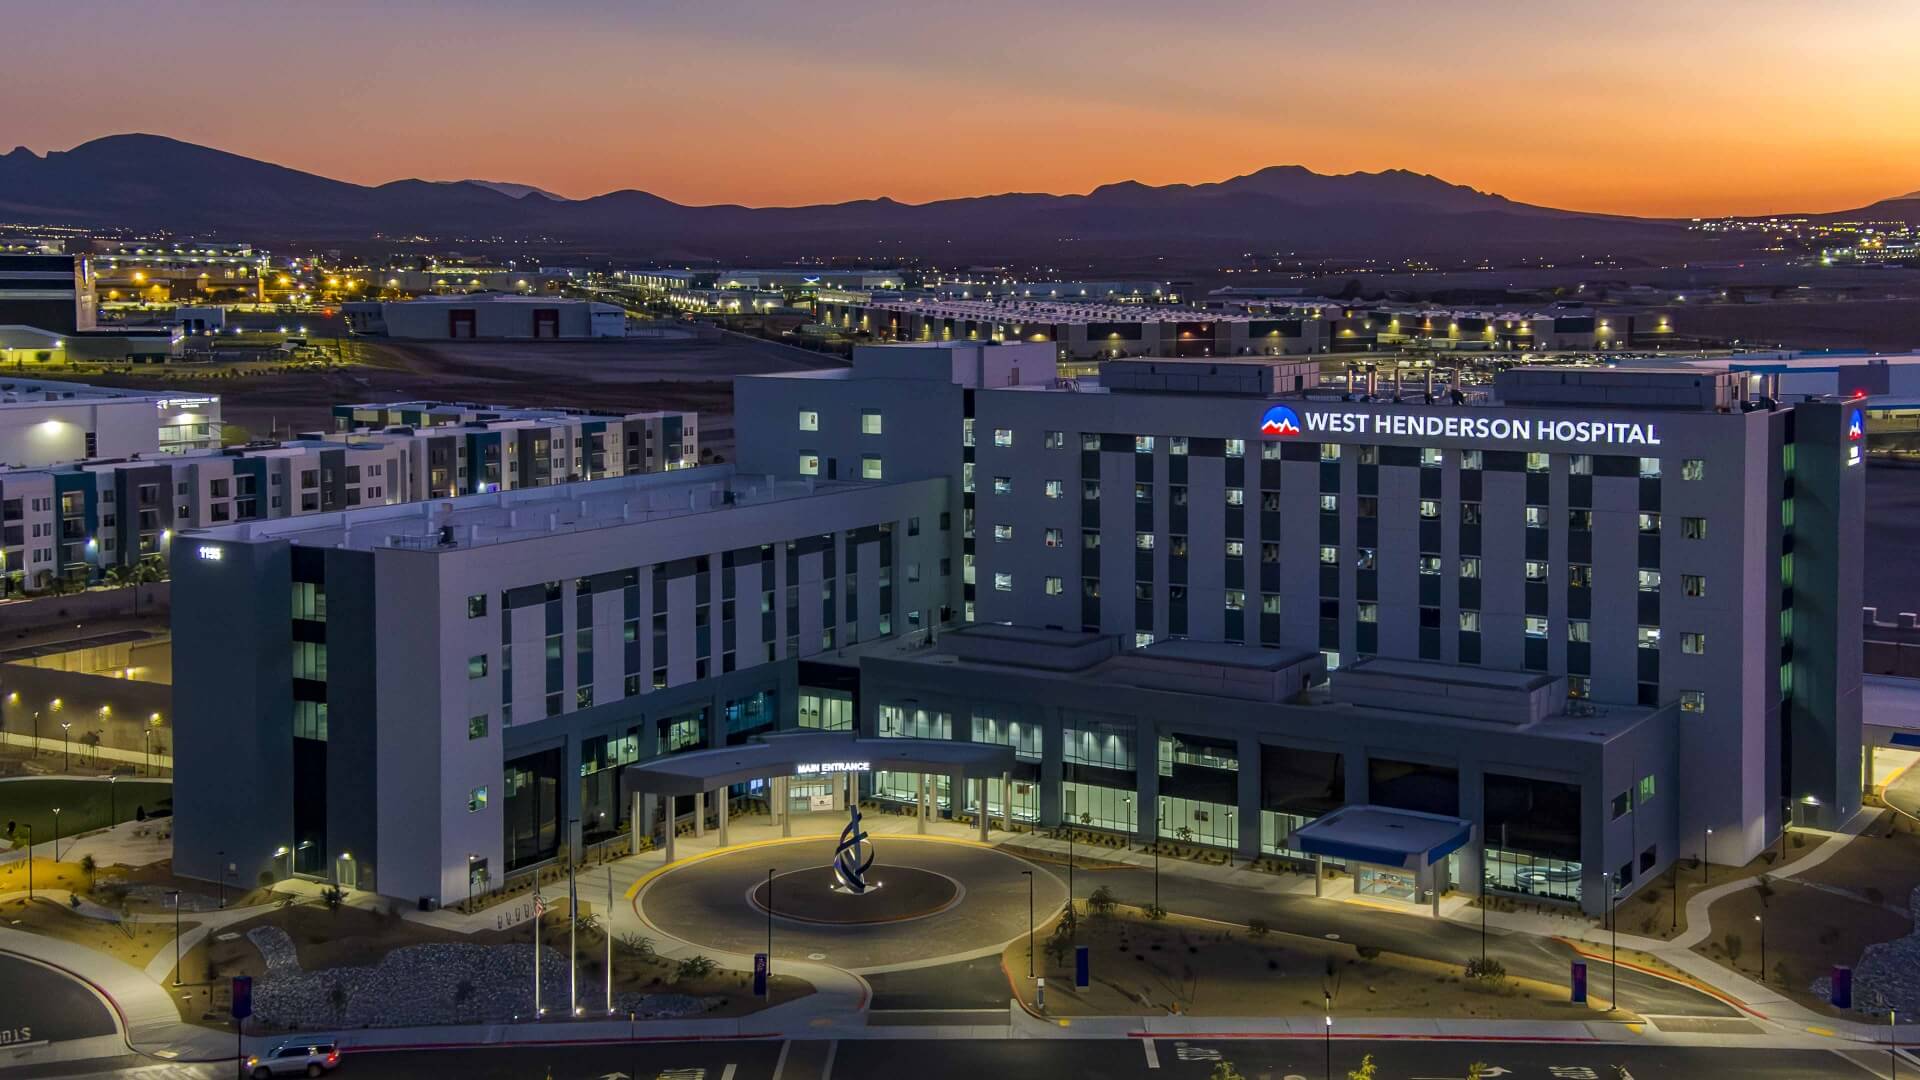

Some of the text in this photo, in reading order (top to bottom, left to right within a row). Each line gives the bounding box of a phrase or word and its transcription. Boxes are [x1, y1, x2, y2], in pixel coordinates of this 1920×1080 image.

[1305, 411, 1661, 445] WEST HENDERSON HOSPITAL
[797, 761, 870, 773] MAIN ENTRANCE
[0, 1027, 32, 1045] STO
